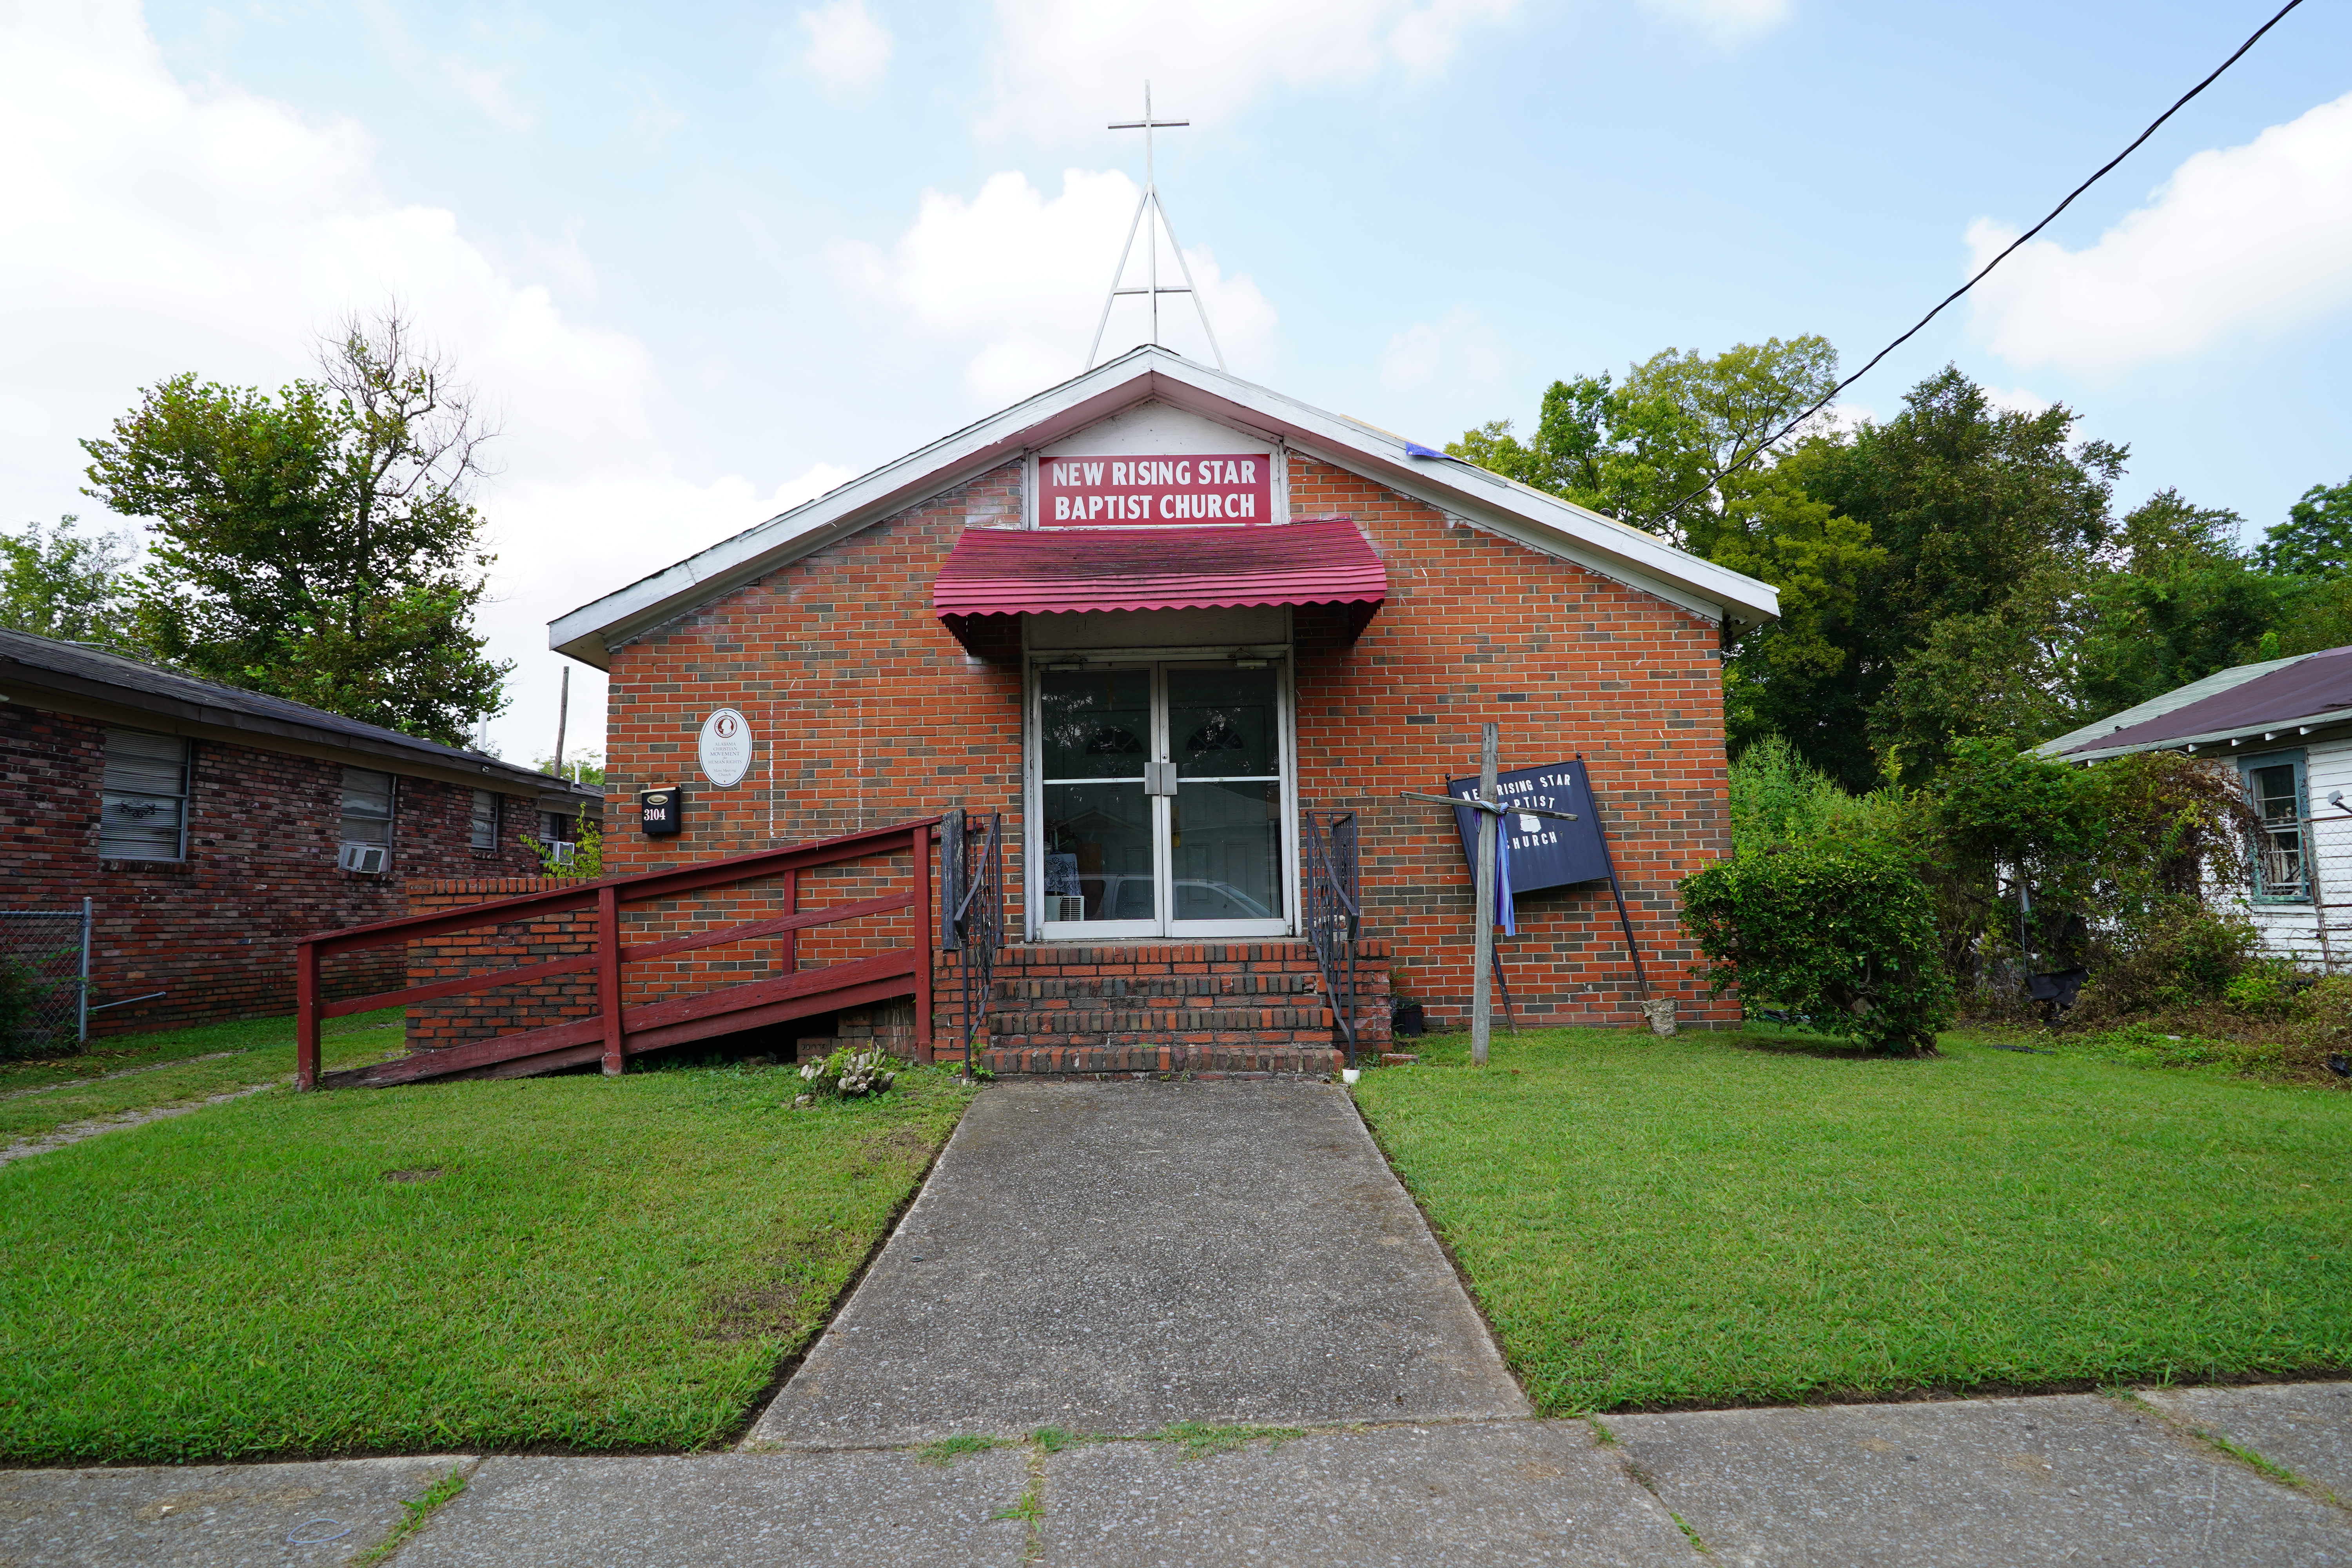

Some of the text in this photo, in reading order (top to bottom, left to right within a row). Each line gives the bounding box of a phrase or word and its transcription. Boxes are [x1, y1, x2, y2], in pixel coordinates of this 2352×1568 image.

[1053, 461, 1256, 486] NEW RISING STAR
[1056, 494, 1254, 520] BAPTIST CHURCH
[1462, 774, 1571, 800] NE RISING STAR
[644, 808, 666, 821] 3104
[1504, 795, 1555, 809] PTIST
